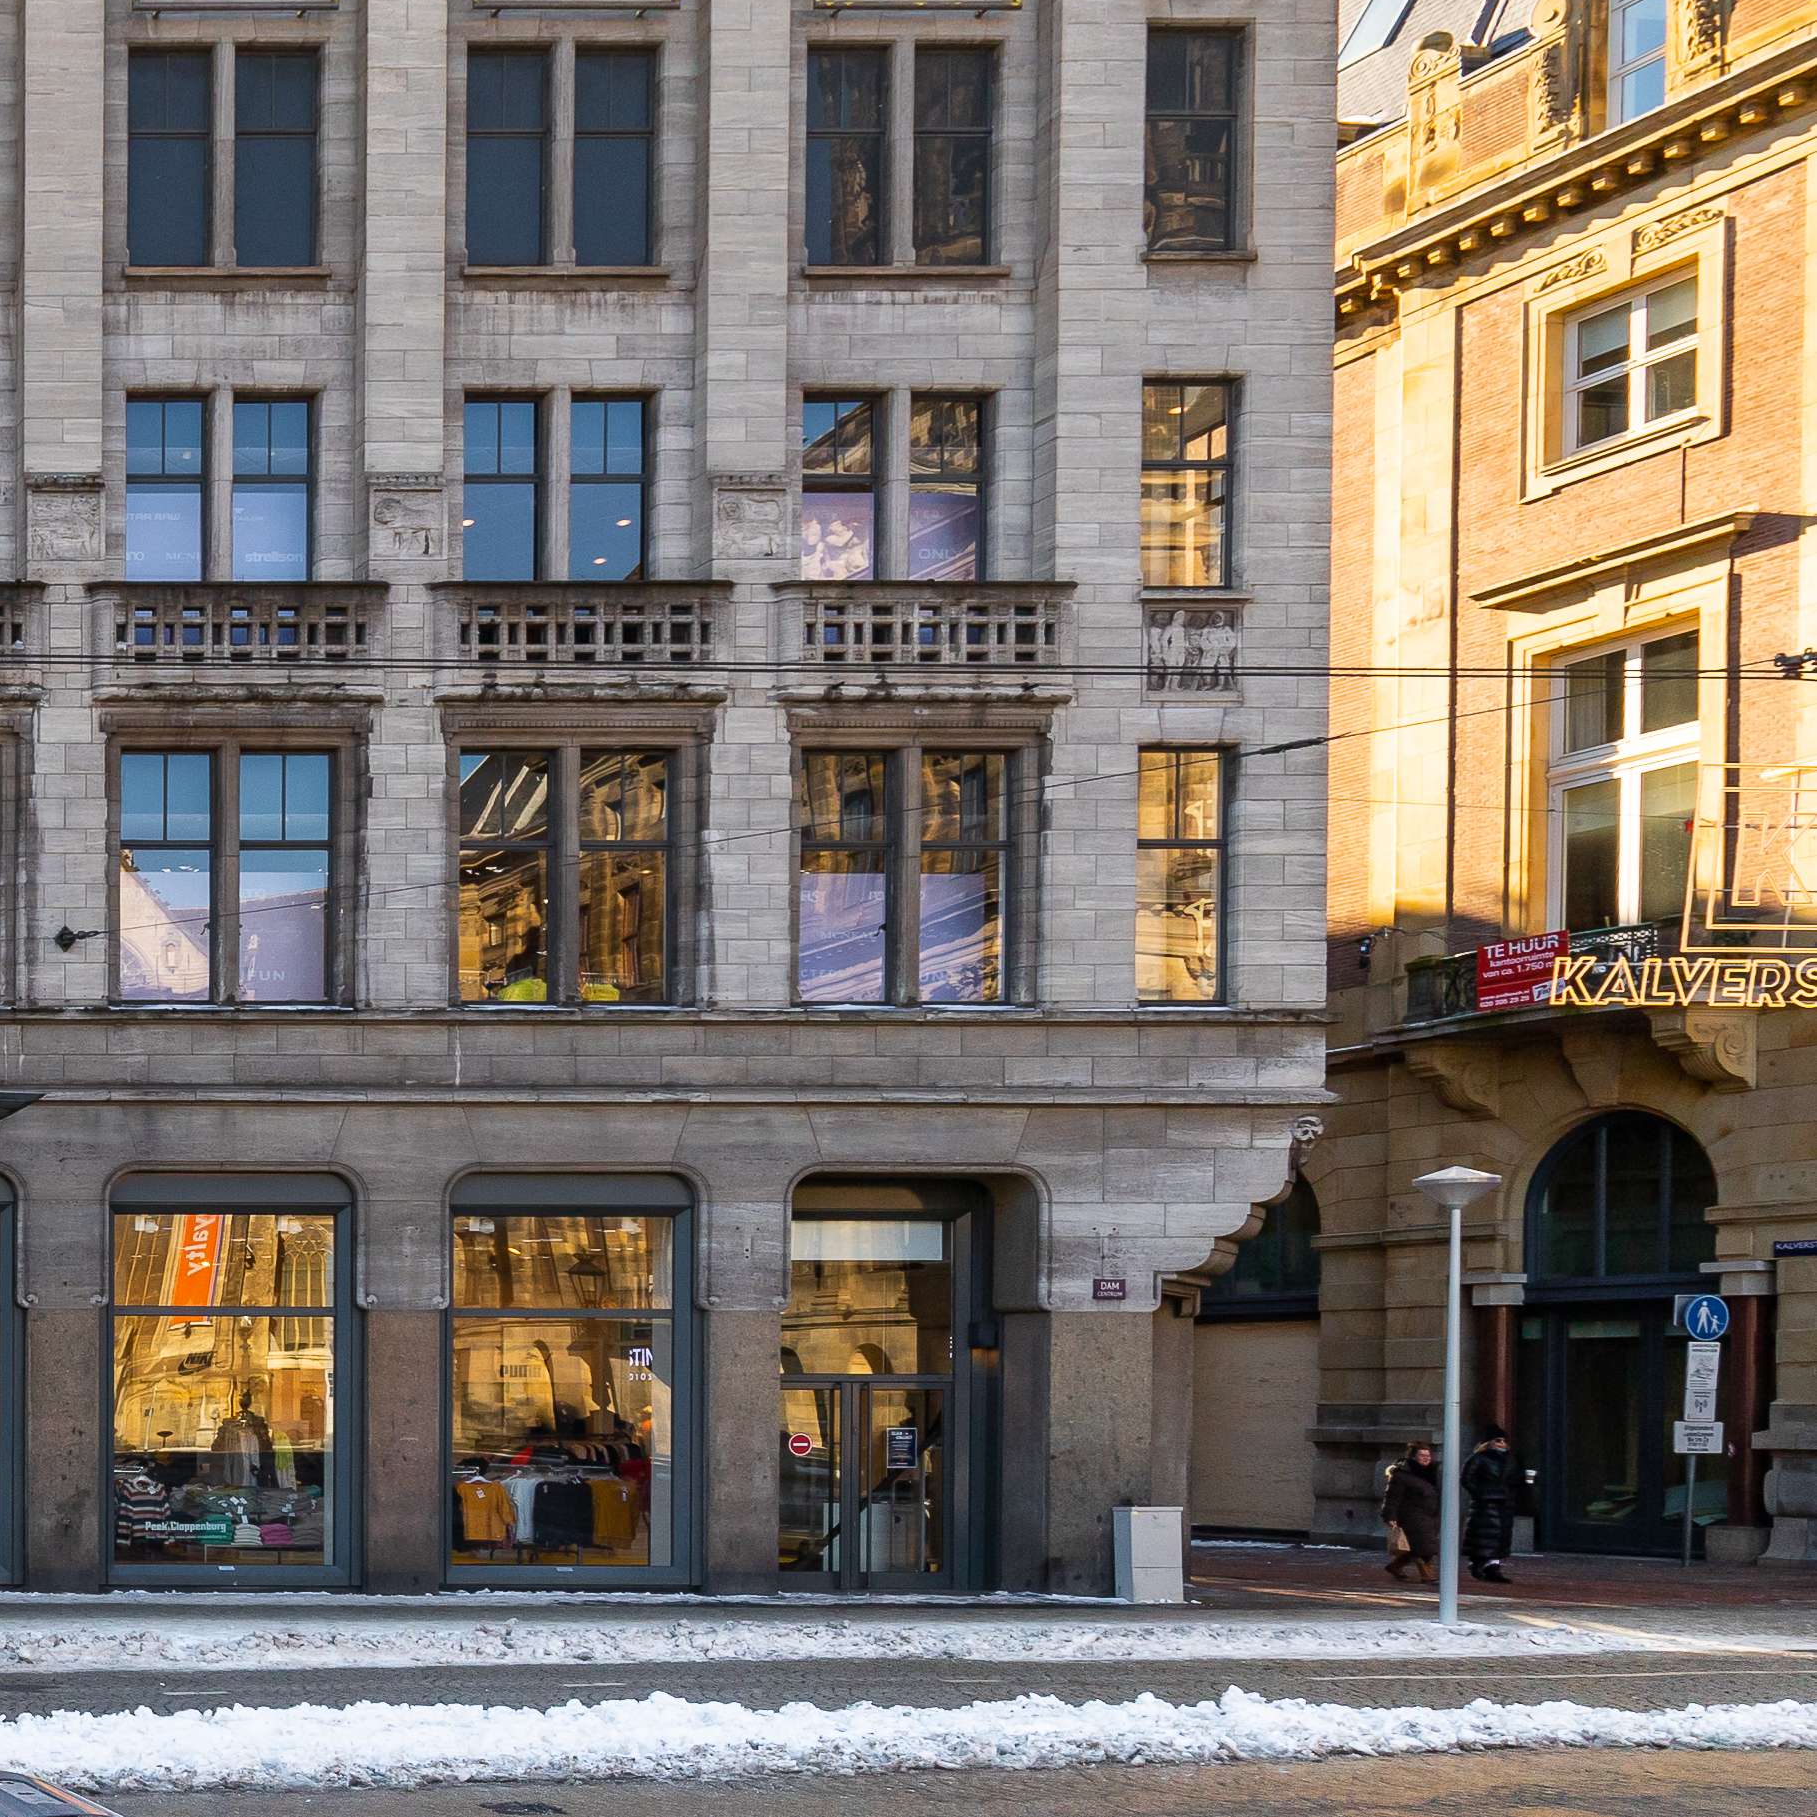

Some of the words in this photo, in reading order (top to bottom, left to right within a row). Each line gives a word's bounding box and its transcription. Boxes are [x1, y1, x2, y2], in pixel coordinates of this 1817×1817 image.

[1483, 944, 1505, 959] TE
[1508, 935, 1560, 956] HUUR
[1550, 956, 1817, 1008] KALVERS
[1100, 1281, 1120, 1290] DAM
